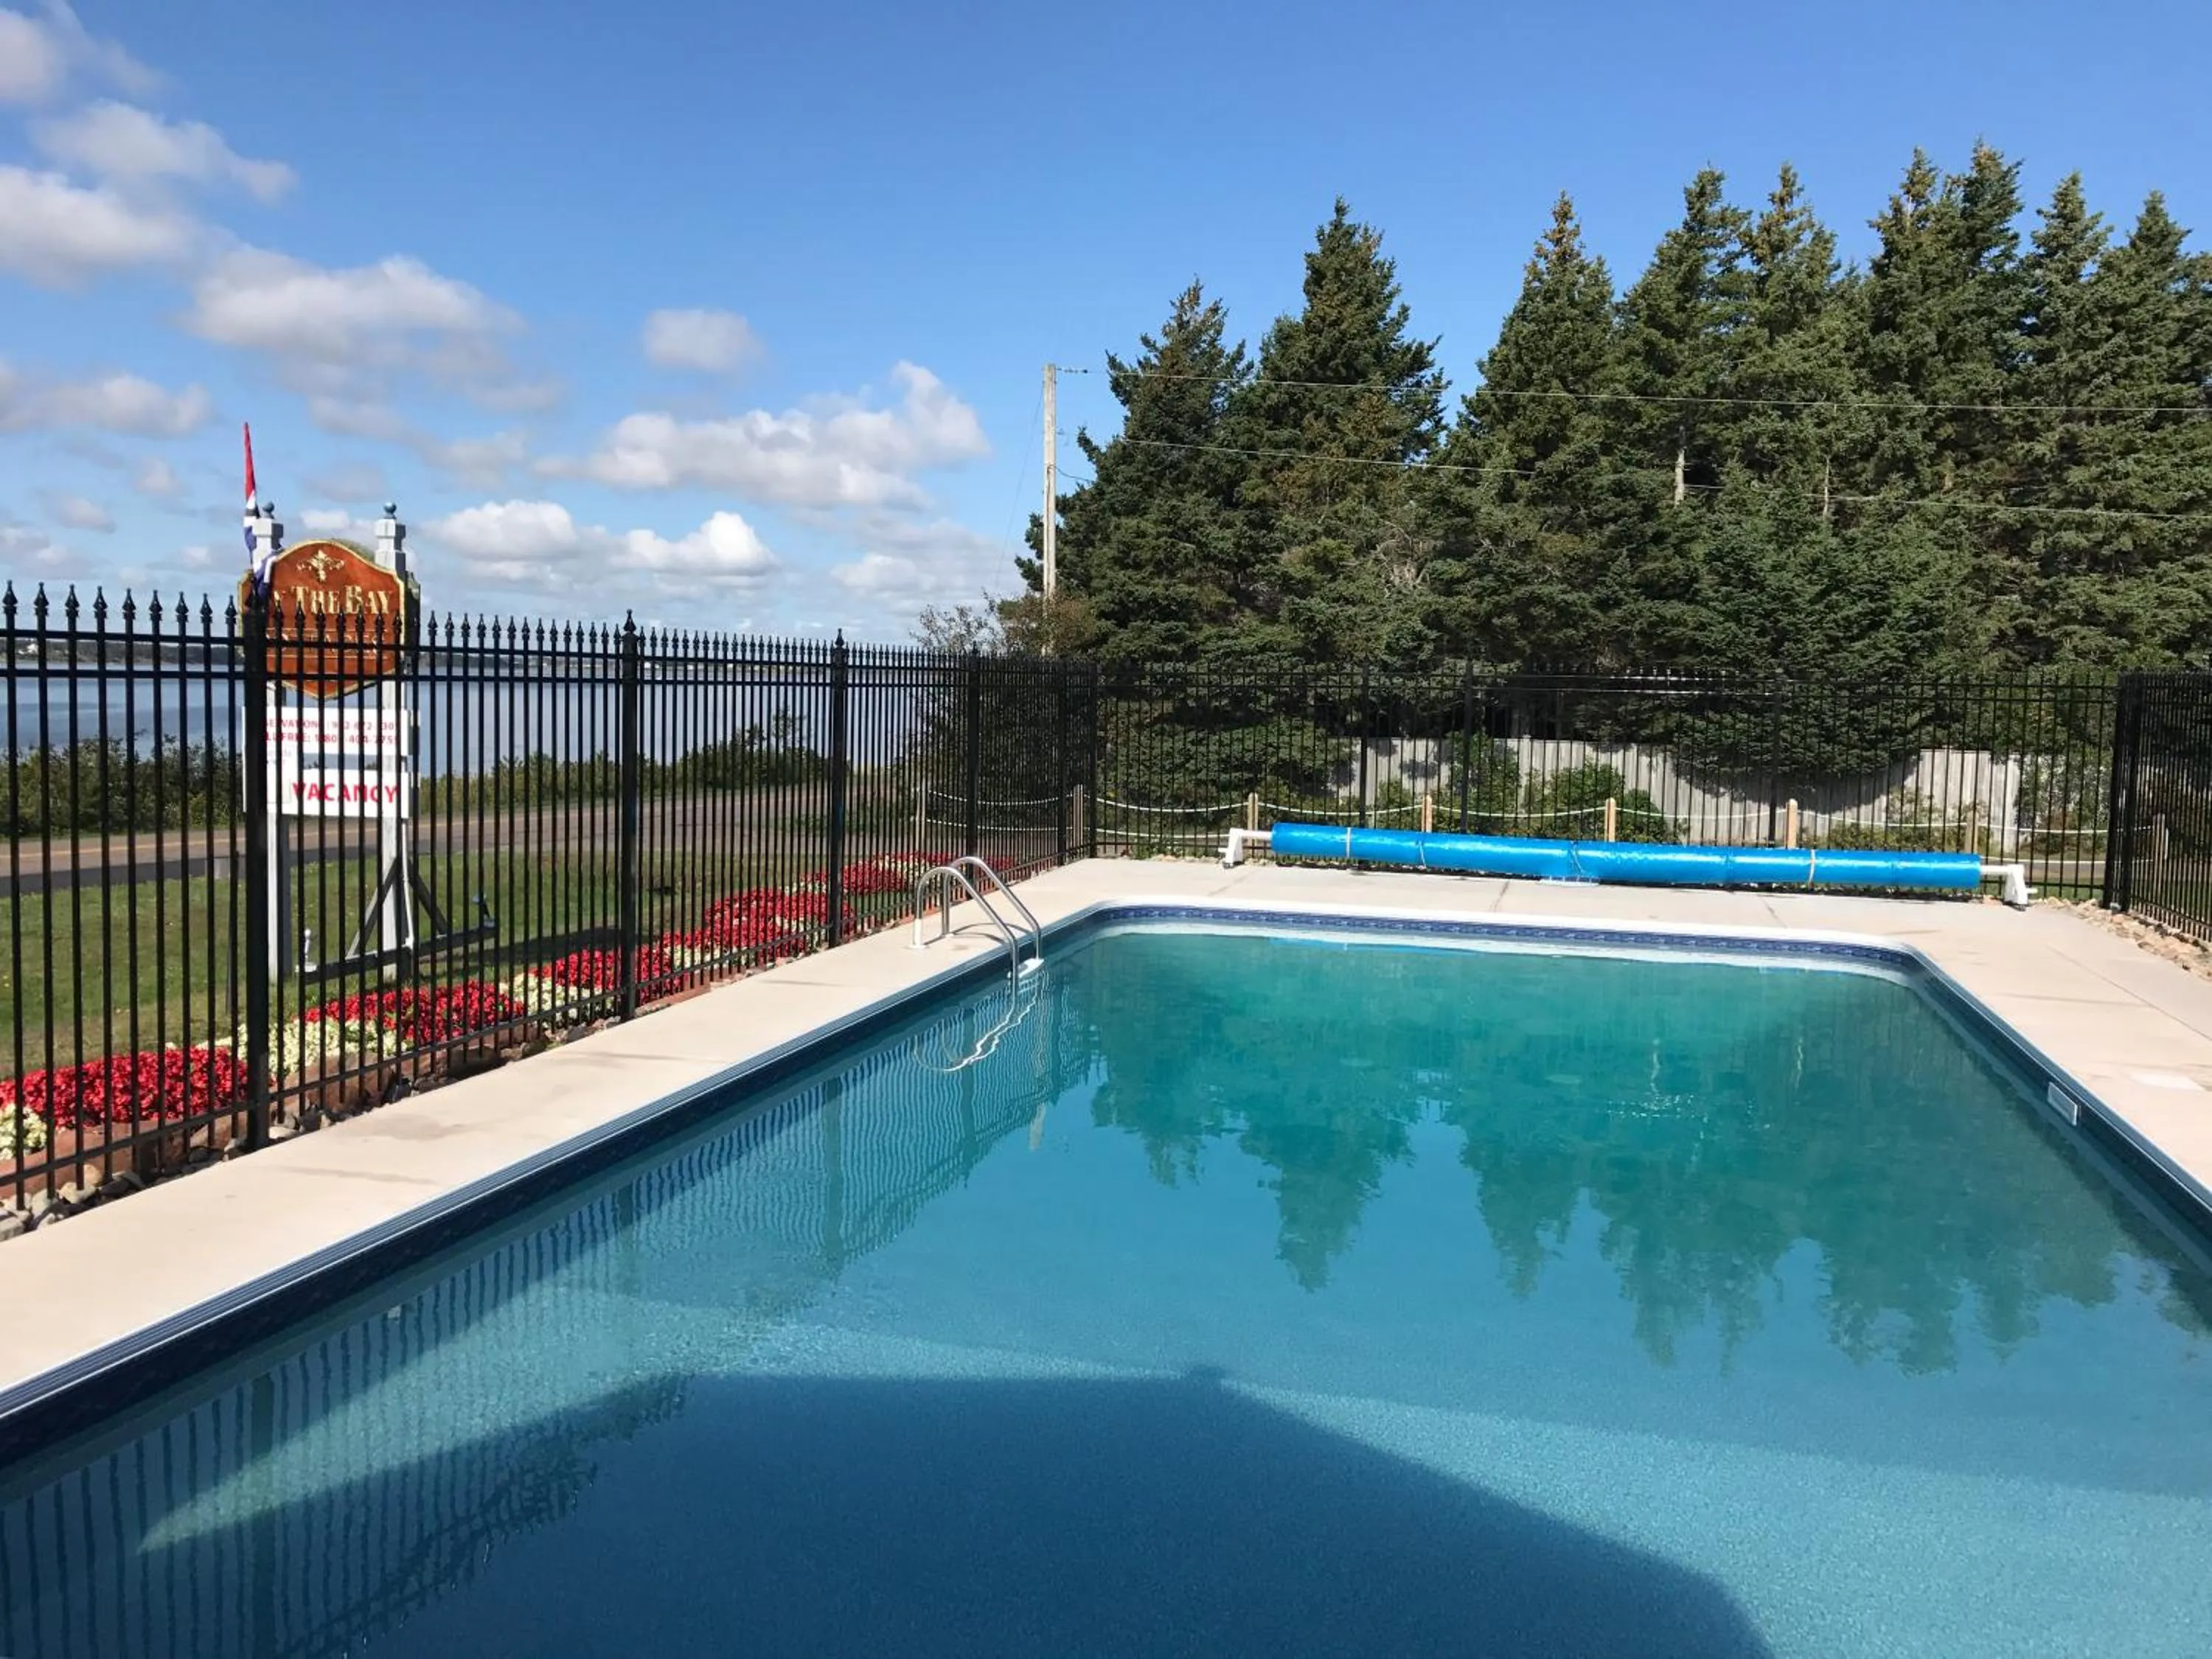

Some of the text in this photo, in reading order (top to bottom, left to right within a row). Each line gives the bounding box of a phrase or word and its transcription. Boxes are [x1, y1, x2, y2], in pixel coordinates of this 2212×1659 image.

[291, 586, 340, 614] THE
[344, 585, 392, 614] BAY
[292, 782, 398, 804] VACANCY
